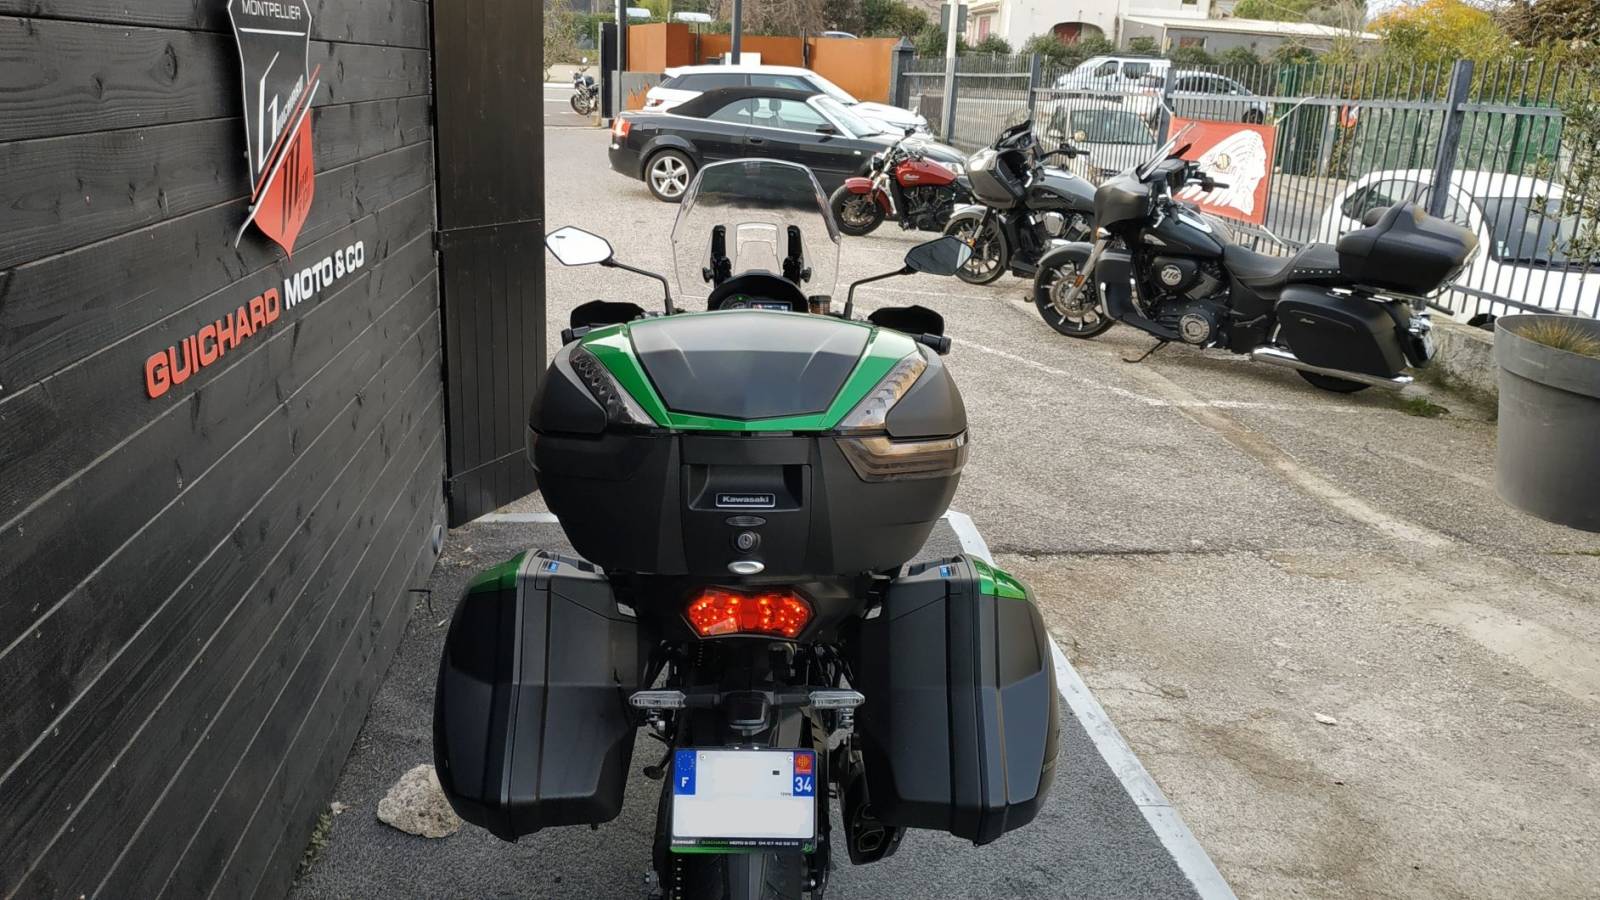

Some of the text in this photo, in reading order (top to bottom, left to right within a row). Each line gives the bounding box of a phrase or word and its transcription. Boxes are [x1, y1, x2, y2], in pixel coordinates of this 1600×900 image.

[241, 0, 301, 20] MONTPELLIER
[145, 287, 280, 398] GUICHARD
[722, 495, 769, 503] Kawasaki
[681, 776, 689, 787] F
[794, 776, 812, 792] 34
